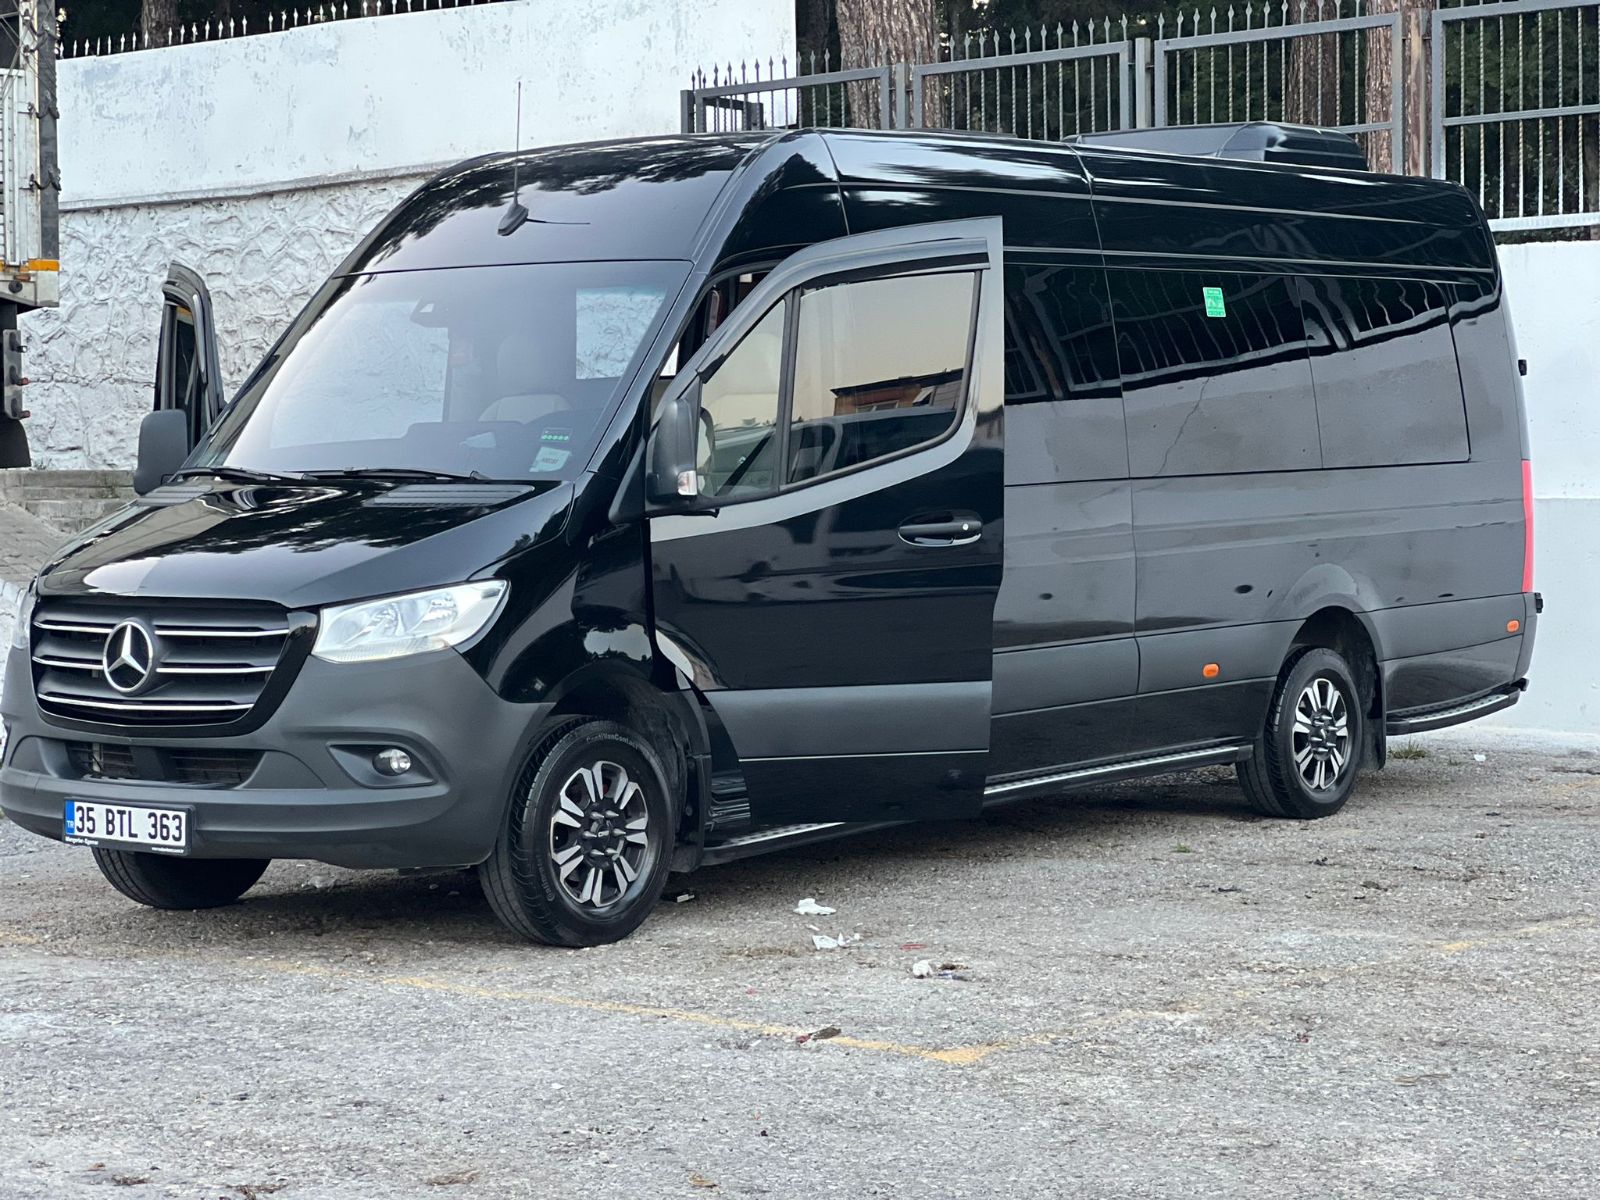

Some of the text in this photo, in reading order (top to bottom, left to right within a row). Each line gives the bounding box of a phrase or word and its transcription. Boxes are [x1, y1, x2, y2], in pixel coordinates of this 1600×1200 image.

[76, 806, 182, 842] 35 BTL 363
